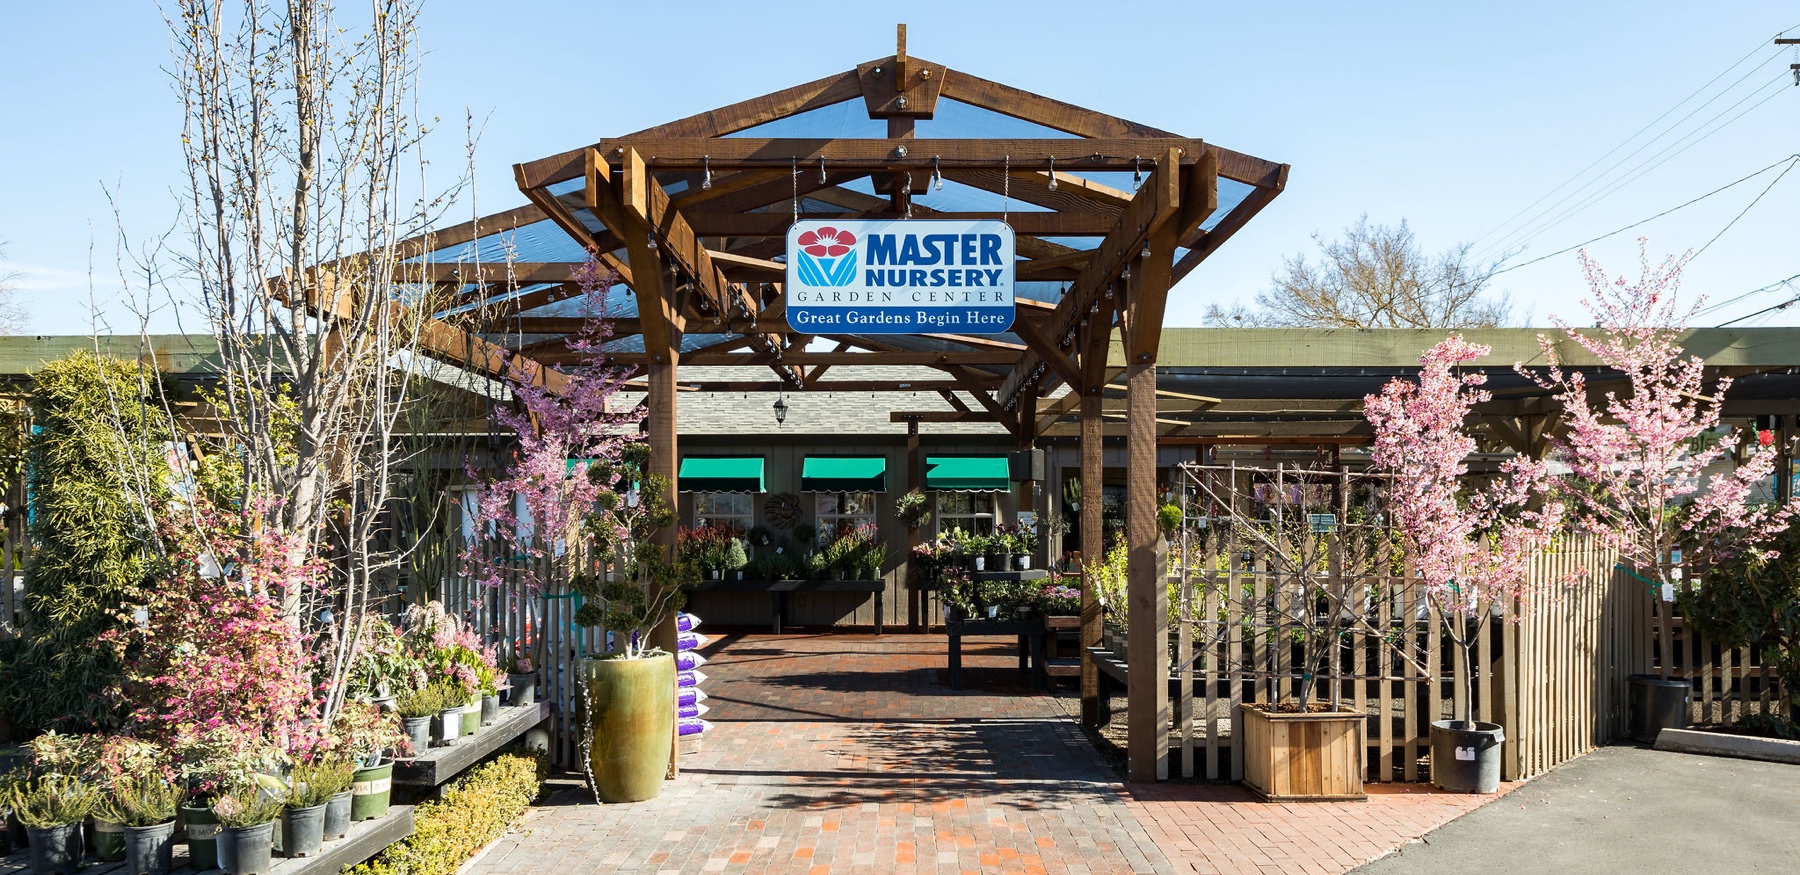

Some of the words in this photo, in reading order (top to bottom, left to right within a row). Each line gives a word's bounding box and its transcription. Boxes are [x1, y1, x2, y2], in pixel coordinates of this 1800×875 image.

[866, 234, 1004, 265] MASTER
[866, 269, 1004, 287] NURSERY
[797, 291, 893, 302] GARDEN
[911, 291, 1004, 302] CENTER
[797, 310, 841, 324] Great
[846, 310, 911, 324] Gardens
[916, 310, 961, 327] Begin
[966, 310, 1005, 324] Here
